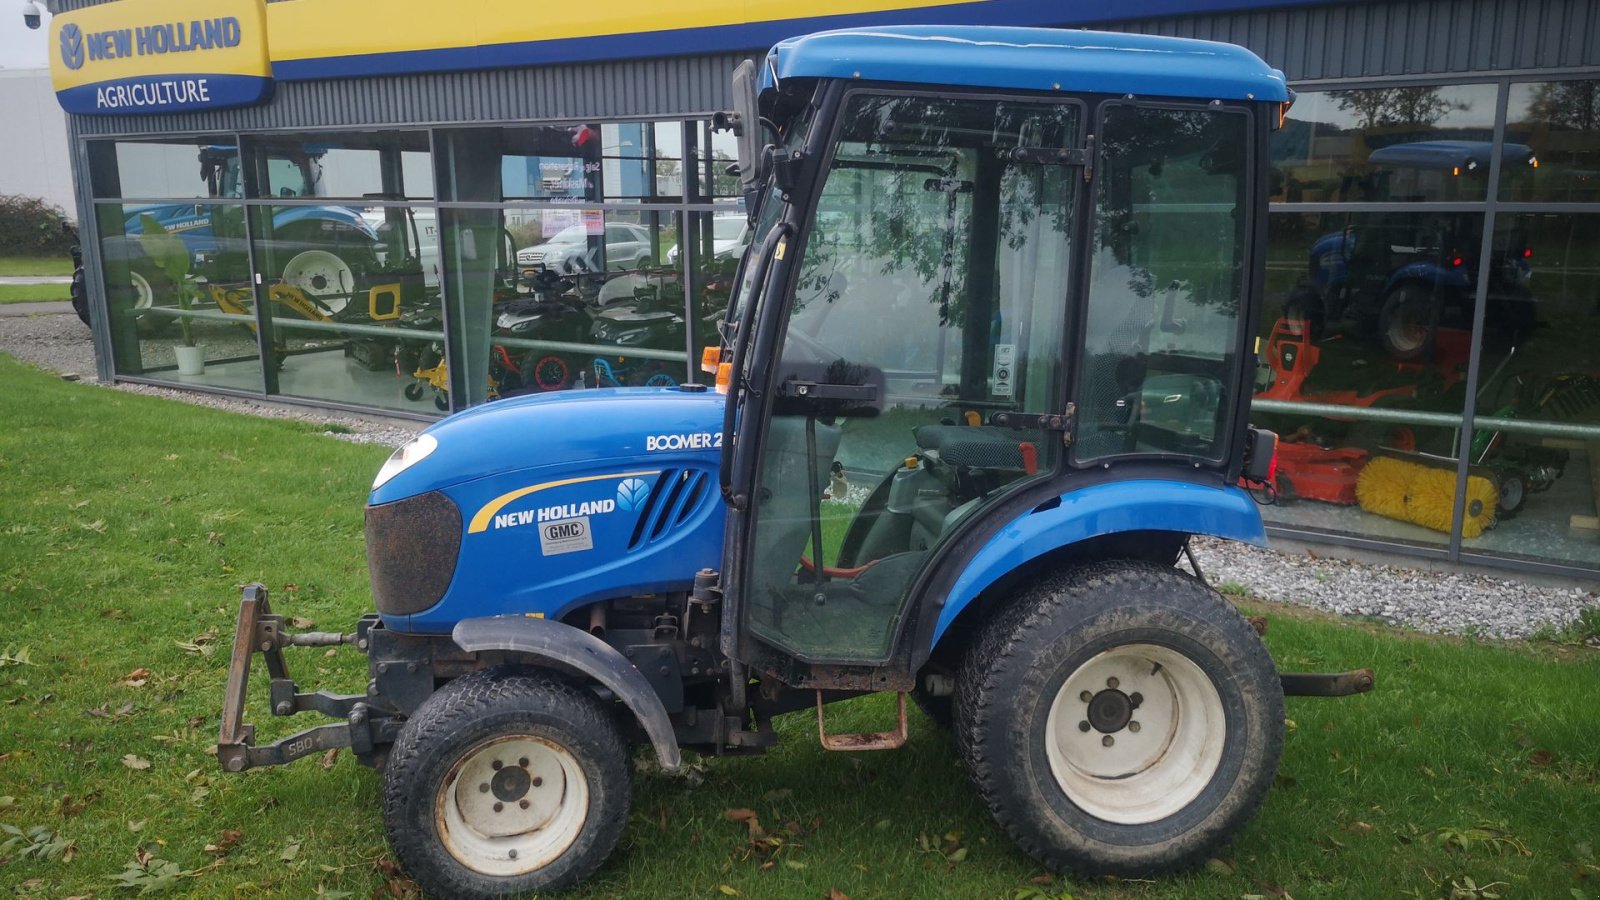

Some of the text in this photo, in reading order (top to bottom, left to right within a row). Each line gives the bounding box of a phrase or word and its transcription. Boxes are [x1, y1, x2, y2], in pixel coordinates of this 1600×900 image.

[86, 17, 241, 61] NEW HOLLAND
[97, 79, 210, 108] AGRICULTURE
[176, 218, 209, 229] HOLLAND
[646, 433, 712, 451] BOOMER
[494, 499, 615, 529] NEW HOLLAND
[550, 523, 579, 539] GMC
